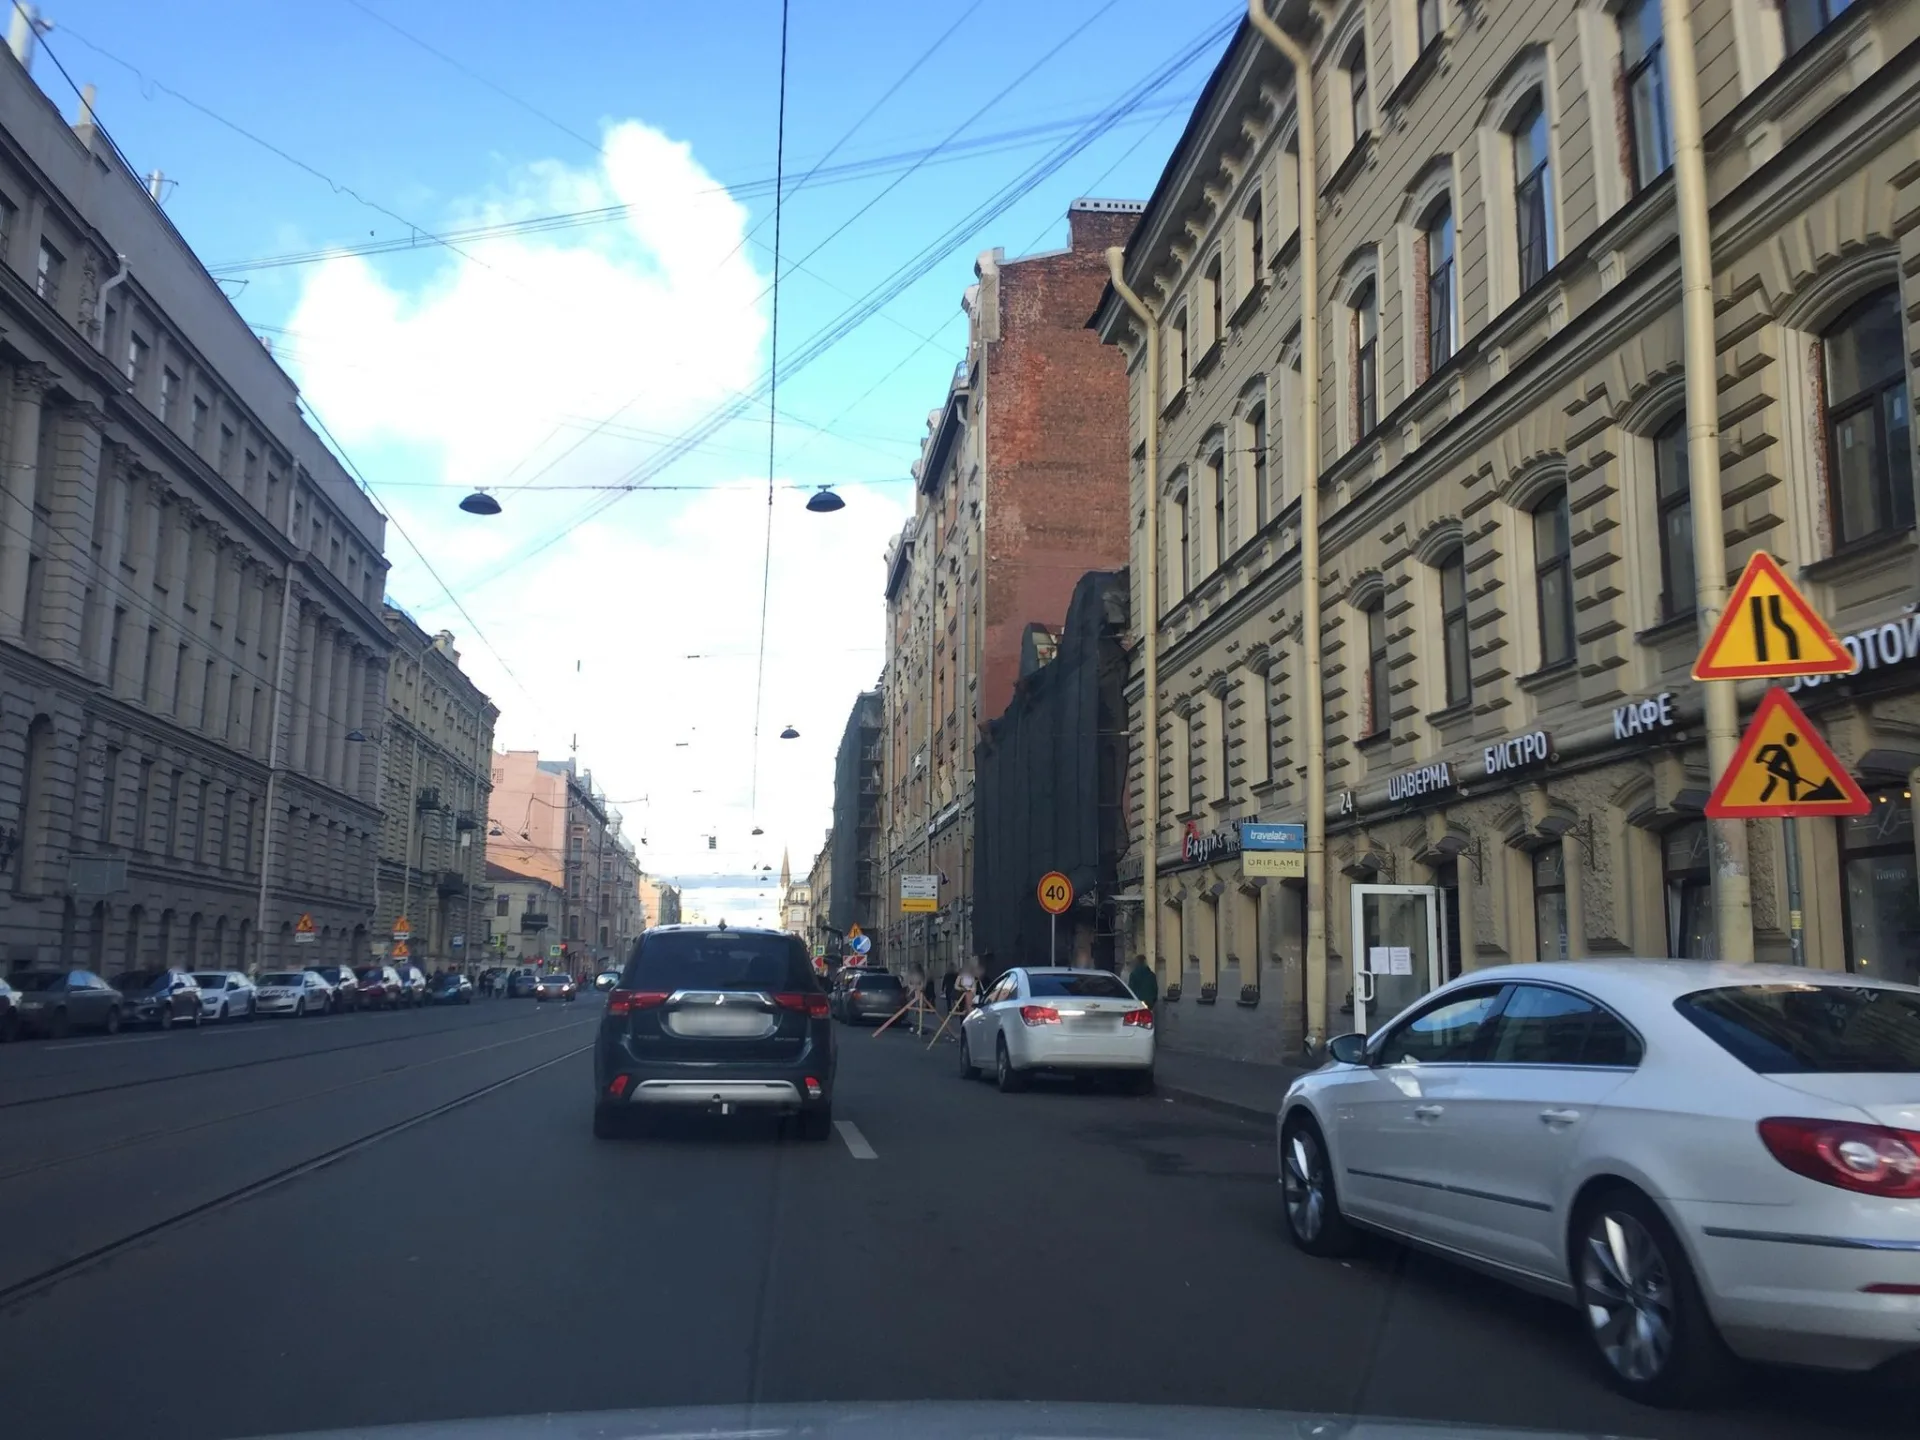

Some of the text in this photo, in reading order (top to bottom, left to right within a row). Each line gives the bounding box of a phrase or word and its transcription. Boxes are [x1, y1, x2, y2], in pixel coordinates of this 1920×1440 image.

[1786, 602, 1920, 693] ОТОЙ
[1340, 692, 1674, 815] 24 ШАВЕРМА БИСТРО КАФЕ
[1247, 858, 1300, 867] ORIFLAME
[1045, 884, 1065, 901] 40
